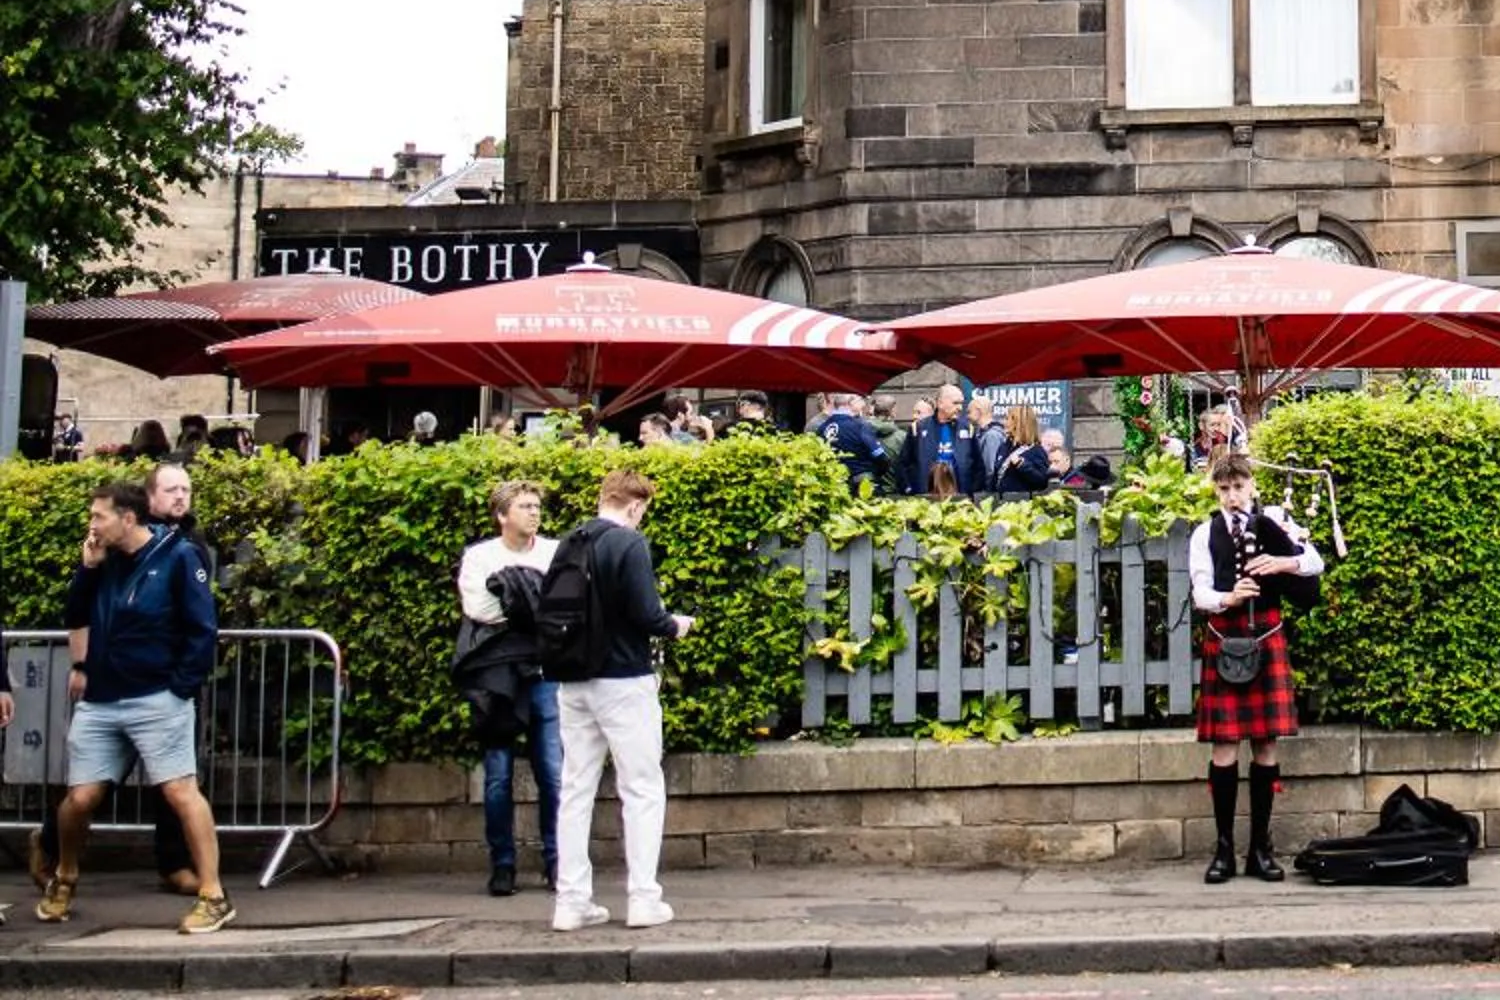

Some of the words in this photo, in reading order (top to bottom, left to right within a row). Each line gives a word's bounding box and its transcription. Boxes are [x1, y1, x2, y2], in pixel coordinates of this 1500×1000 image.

[271, 247, 364, 278] THE
[390, 242, 549, 284] BOTHY
[971, 387, 1061, 405] SUMMER
